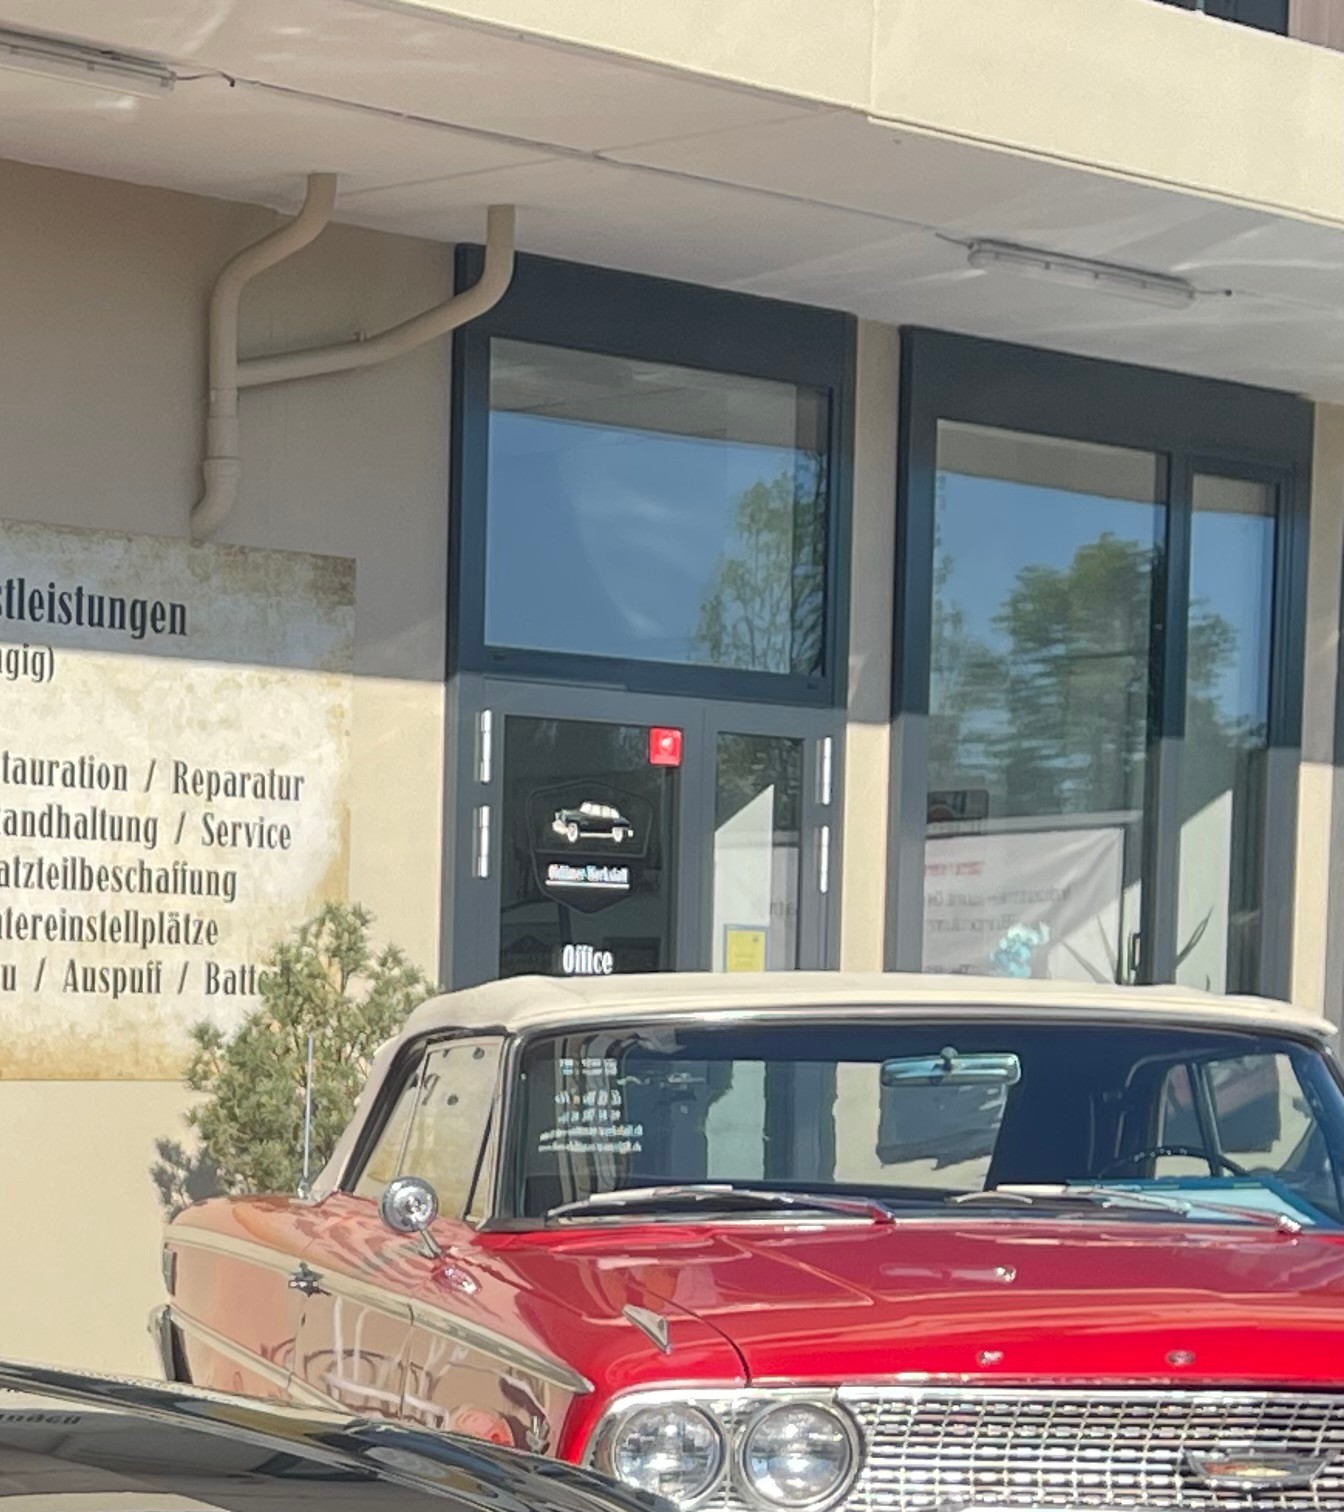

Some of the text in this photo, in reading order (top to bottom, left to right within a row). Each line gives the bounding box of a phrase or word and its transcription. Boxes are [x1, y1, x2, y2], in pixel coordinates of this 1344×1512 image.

[144, 759, 156, 792] /
[173, 761, 304, 802] Reparatur
[175, 812, 186, 844] /
[202, 812, 291, 850] Service
[34, 958, 46, 992] /
[63, 959, 162, 999] Auspuff
[178, 961, 189, 994] /
[562, 944, 614, 974] Office
